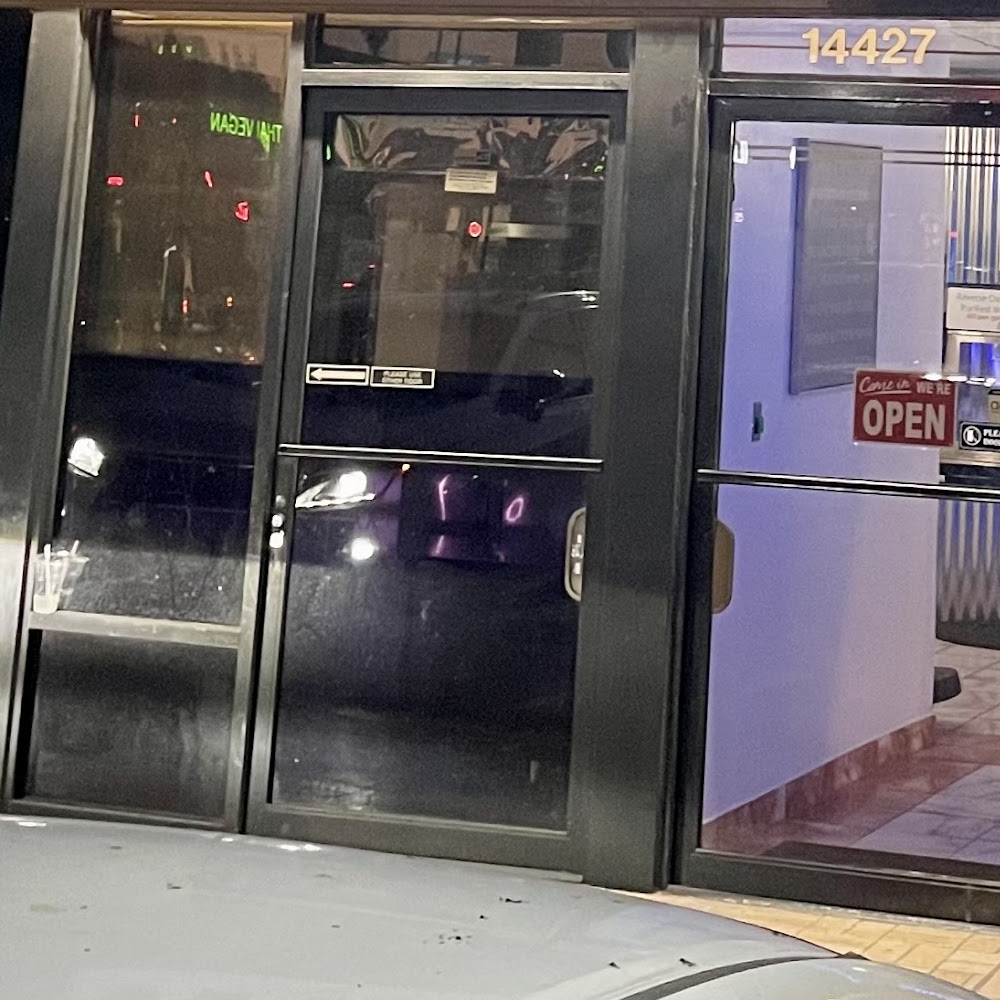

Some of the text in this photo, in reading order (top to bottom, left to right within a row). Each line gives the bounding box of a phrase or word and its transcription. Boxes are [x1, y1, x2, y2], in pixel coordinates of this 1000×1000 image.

[802, 27, 937, 65] 14427
[859, 376, 895, 393] Come
[896, 379, 911, 391] in
[862, 399, 946, 440] OPEN
